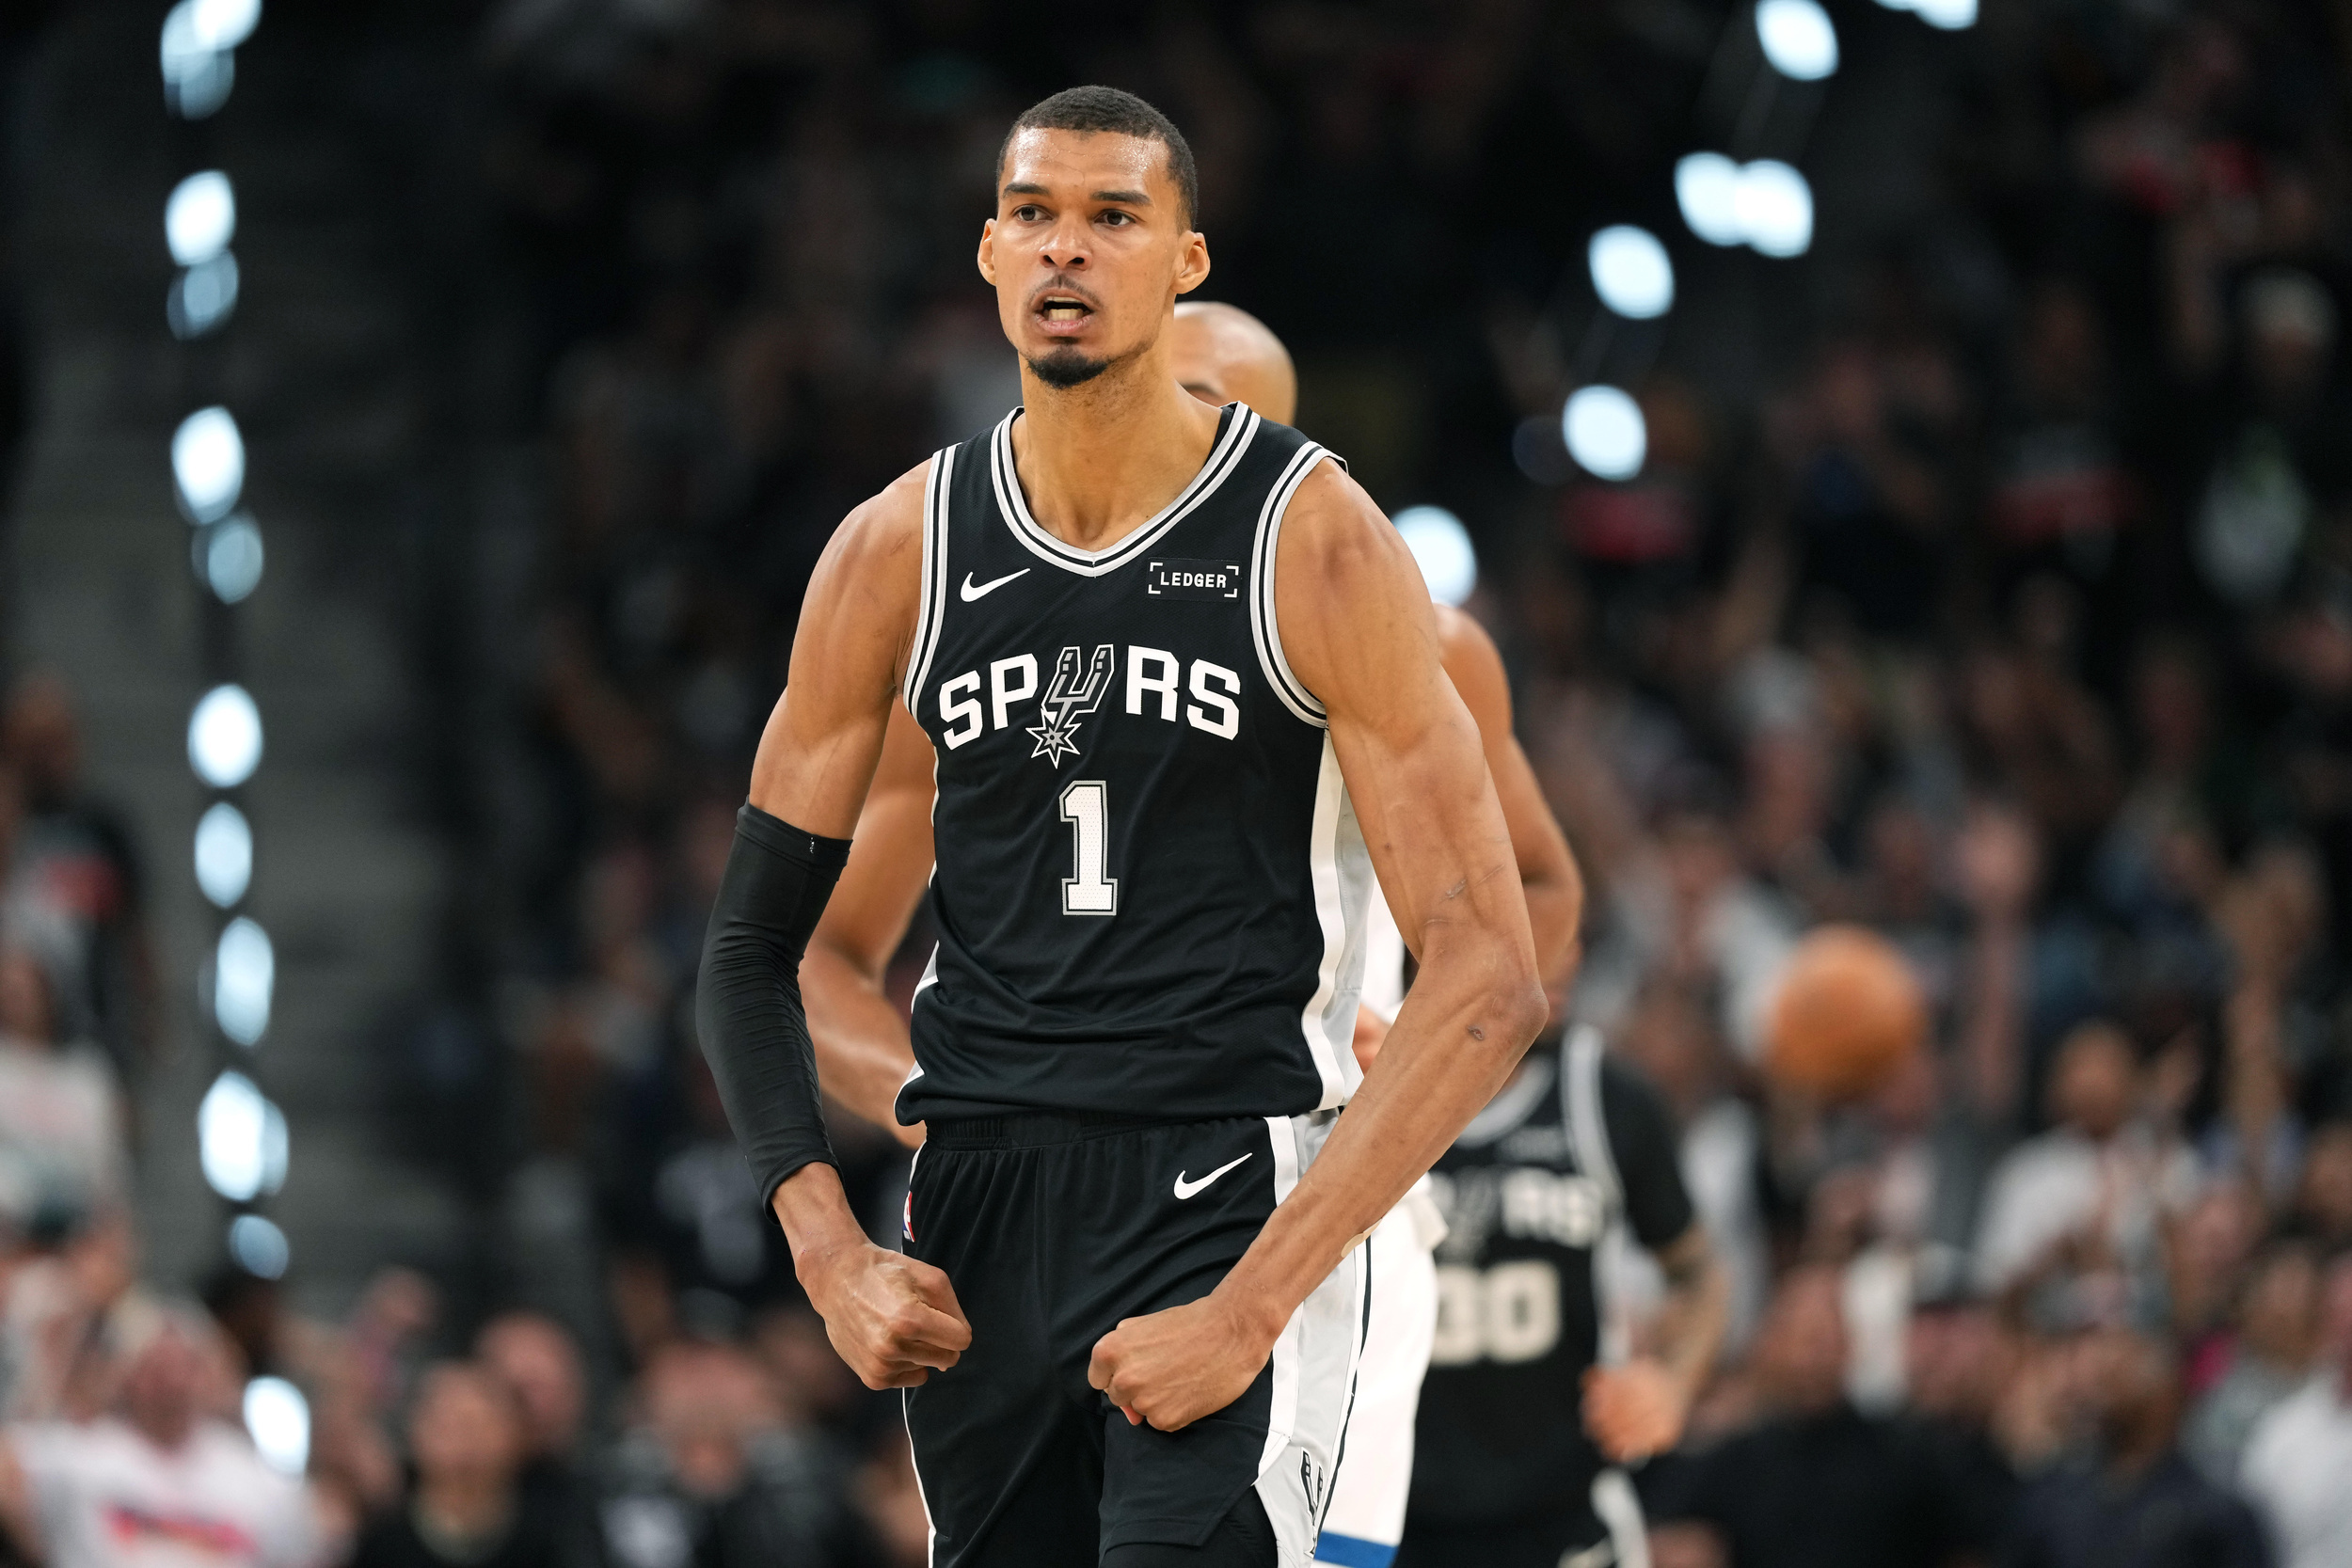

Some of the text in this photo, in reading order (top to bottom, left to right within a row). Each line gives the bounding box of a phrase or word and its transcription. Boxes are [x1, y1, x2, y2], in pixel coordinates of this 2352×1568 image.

[1160, 571, 1227, 589] LEDGER
[939, 644, 1241, 769] SPURS
[1058, 780, 1118, 915] 1
